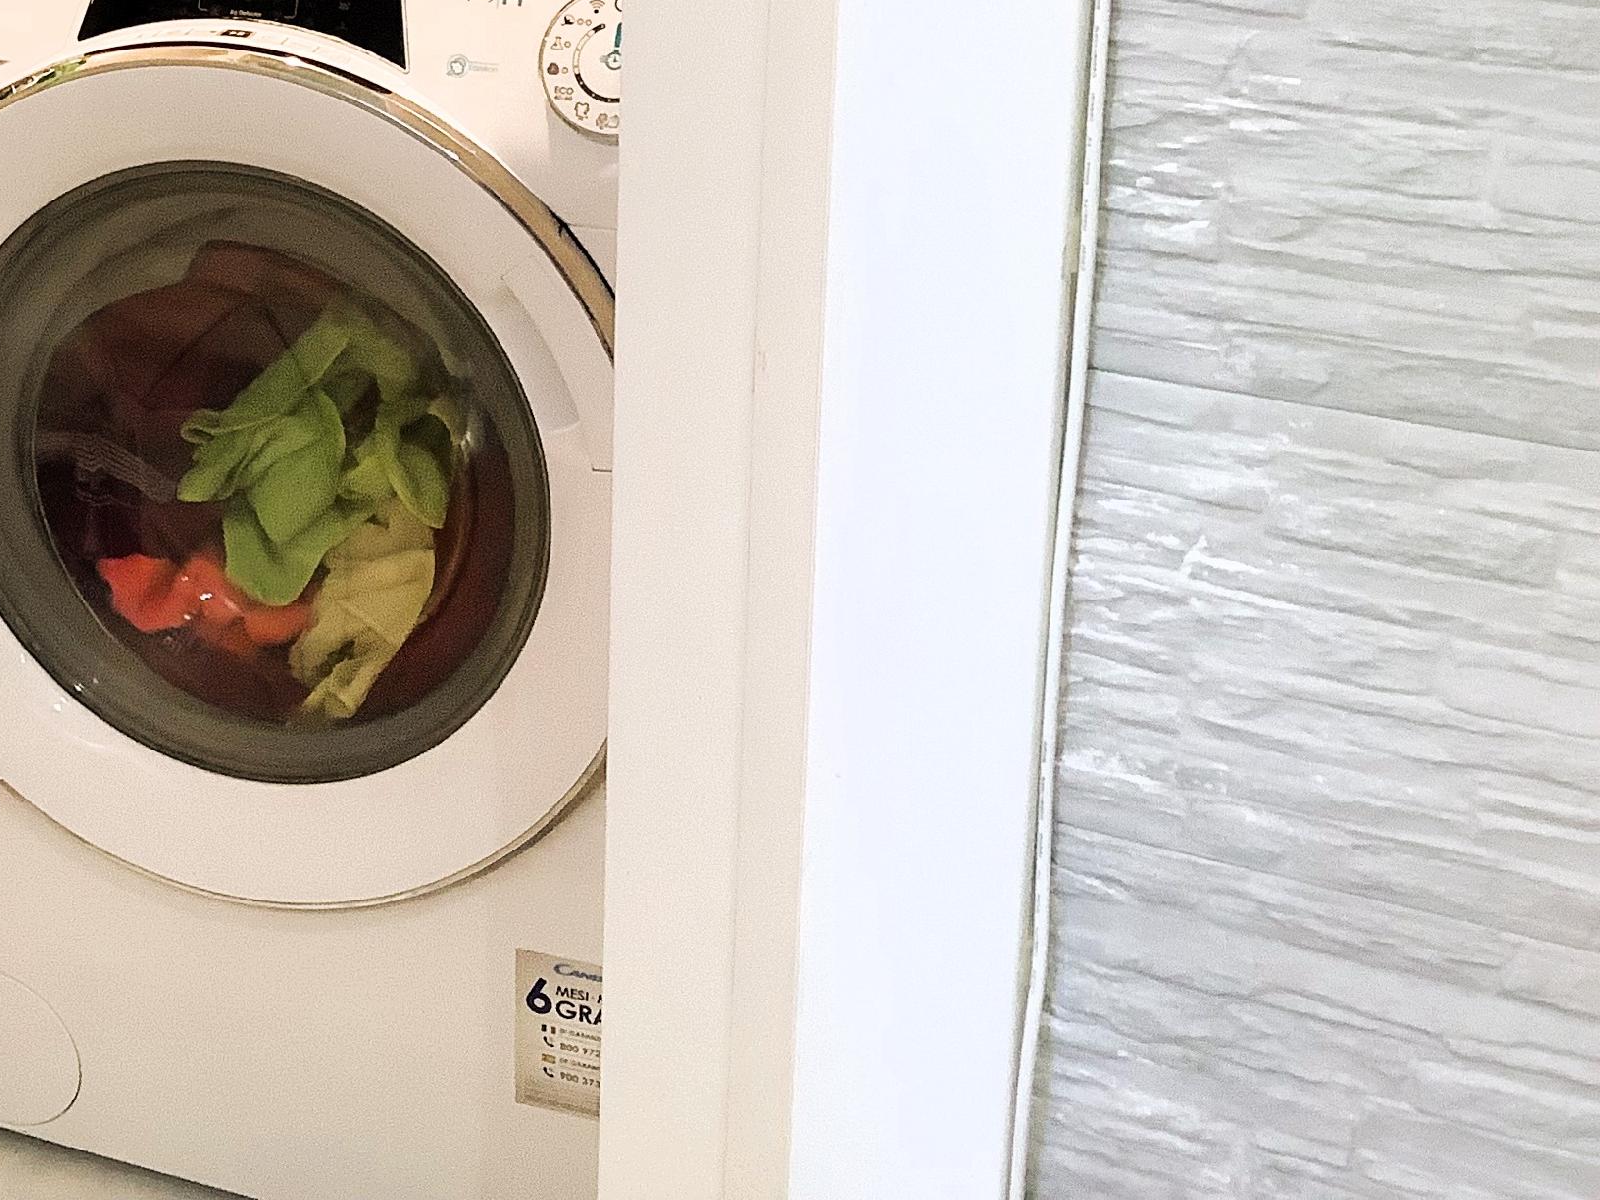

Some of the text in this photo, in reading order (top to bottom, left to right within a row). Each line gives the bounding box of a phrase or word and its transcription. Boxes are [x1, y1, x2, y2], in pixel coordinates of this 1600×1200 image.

[554, 85, 574, 96] ECO
[525, 977, 589, 1014] 6 MESI
